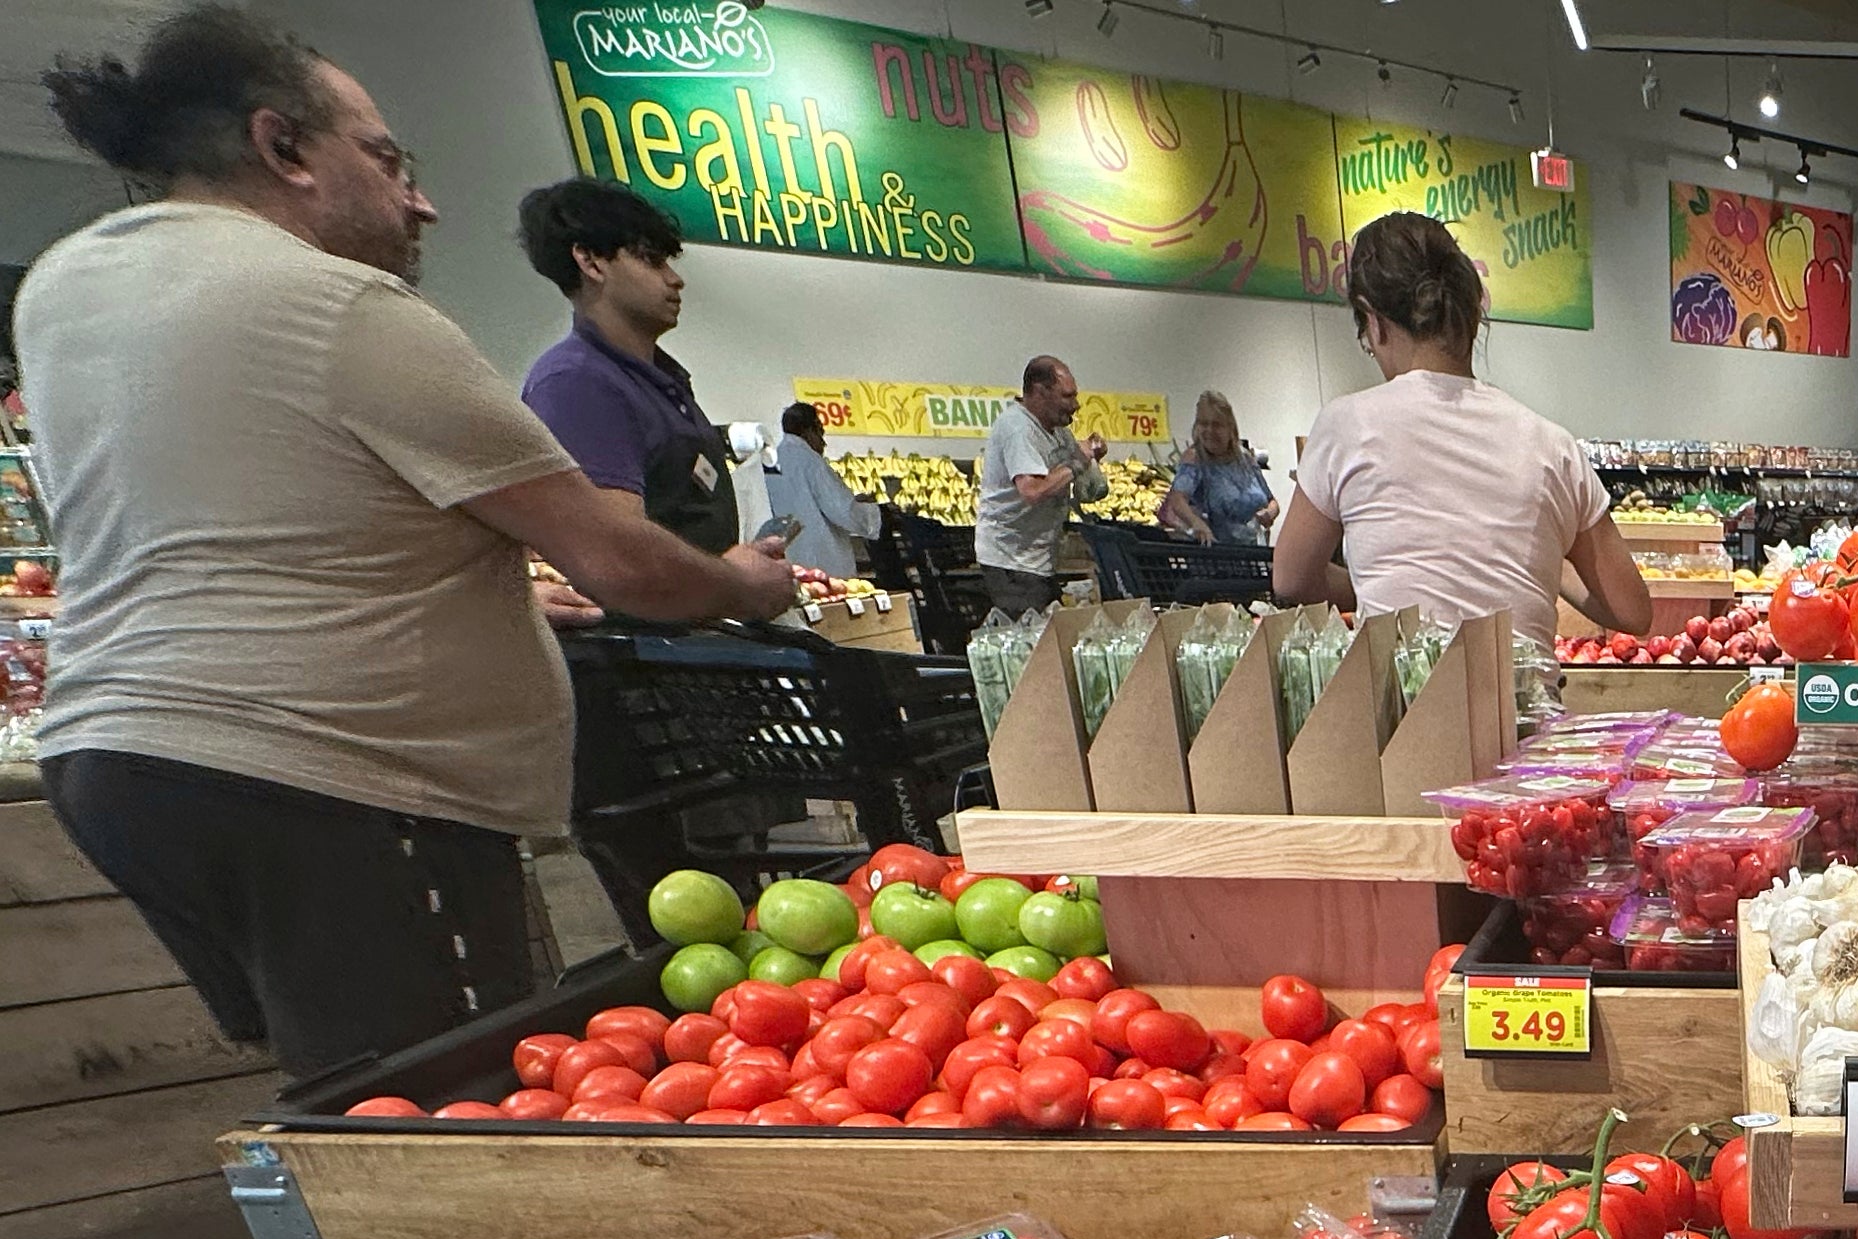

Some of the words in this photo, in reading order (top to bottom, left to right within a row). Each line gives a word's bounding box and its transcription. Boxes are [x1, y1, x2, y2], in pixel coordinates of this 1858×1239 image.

[601, 5, 652, 26] your
[657, 3, 702, 24] local
[589, 24, 763, 70] MARIANO'S
[872, 40, 1041, 139] nuts
[555, 60, 864, 211] health
[880, 172, 916, 215] &
[1341, 131, 1454, 195] nature's
[1543, 158, 1568, 187] EXIT
[1426, 158, 1521, 224] energy
[711, 184, 976, 266] HAPPINESS
[1502, 192, 1578, 268] snack
[1127, 415, 1158, 437] 79¢
[1811, 683, 1832, 693] USDA
[1482, 989, 1511, 998] Organic
[1513, 989, 1535, 998] Grape
[1537, 989, 1573, 998] Tomatoes
[1514, 976, 1540, 988] SALE
[1491, 1010, 1566, 1042] 3.49
